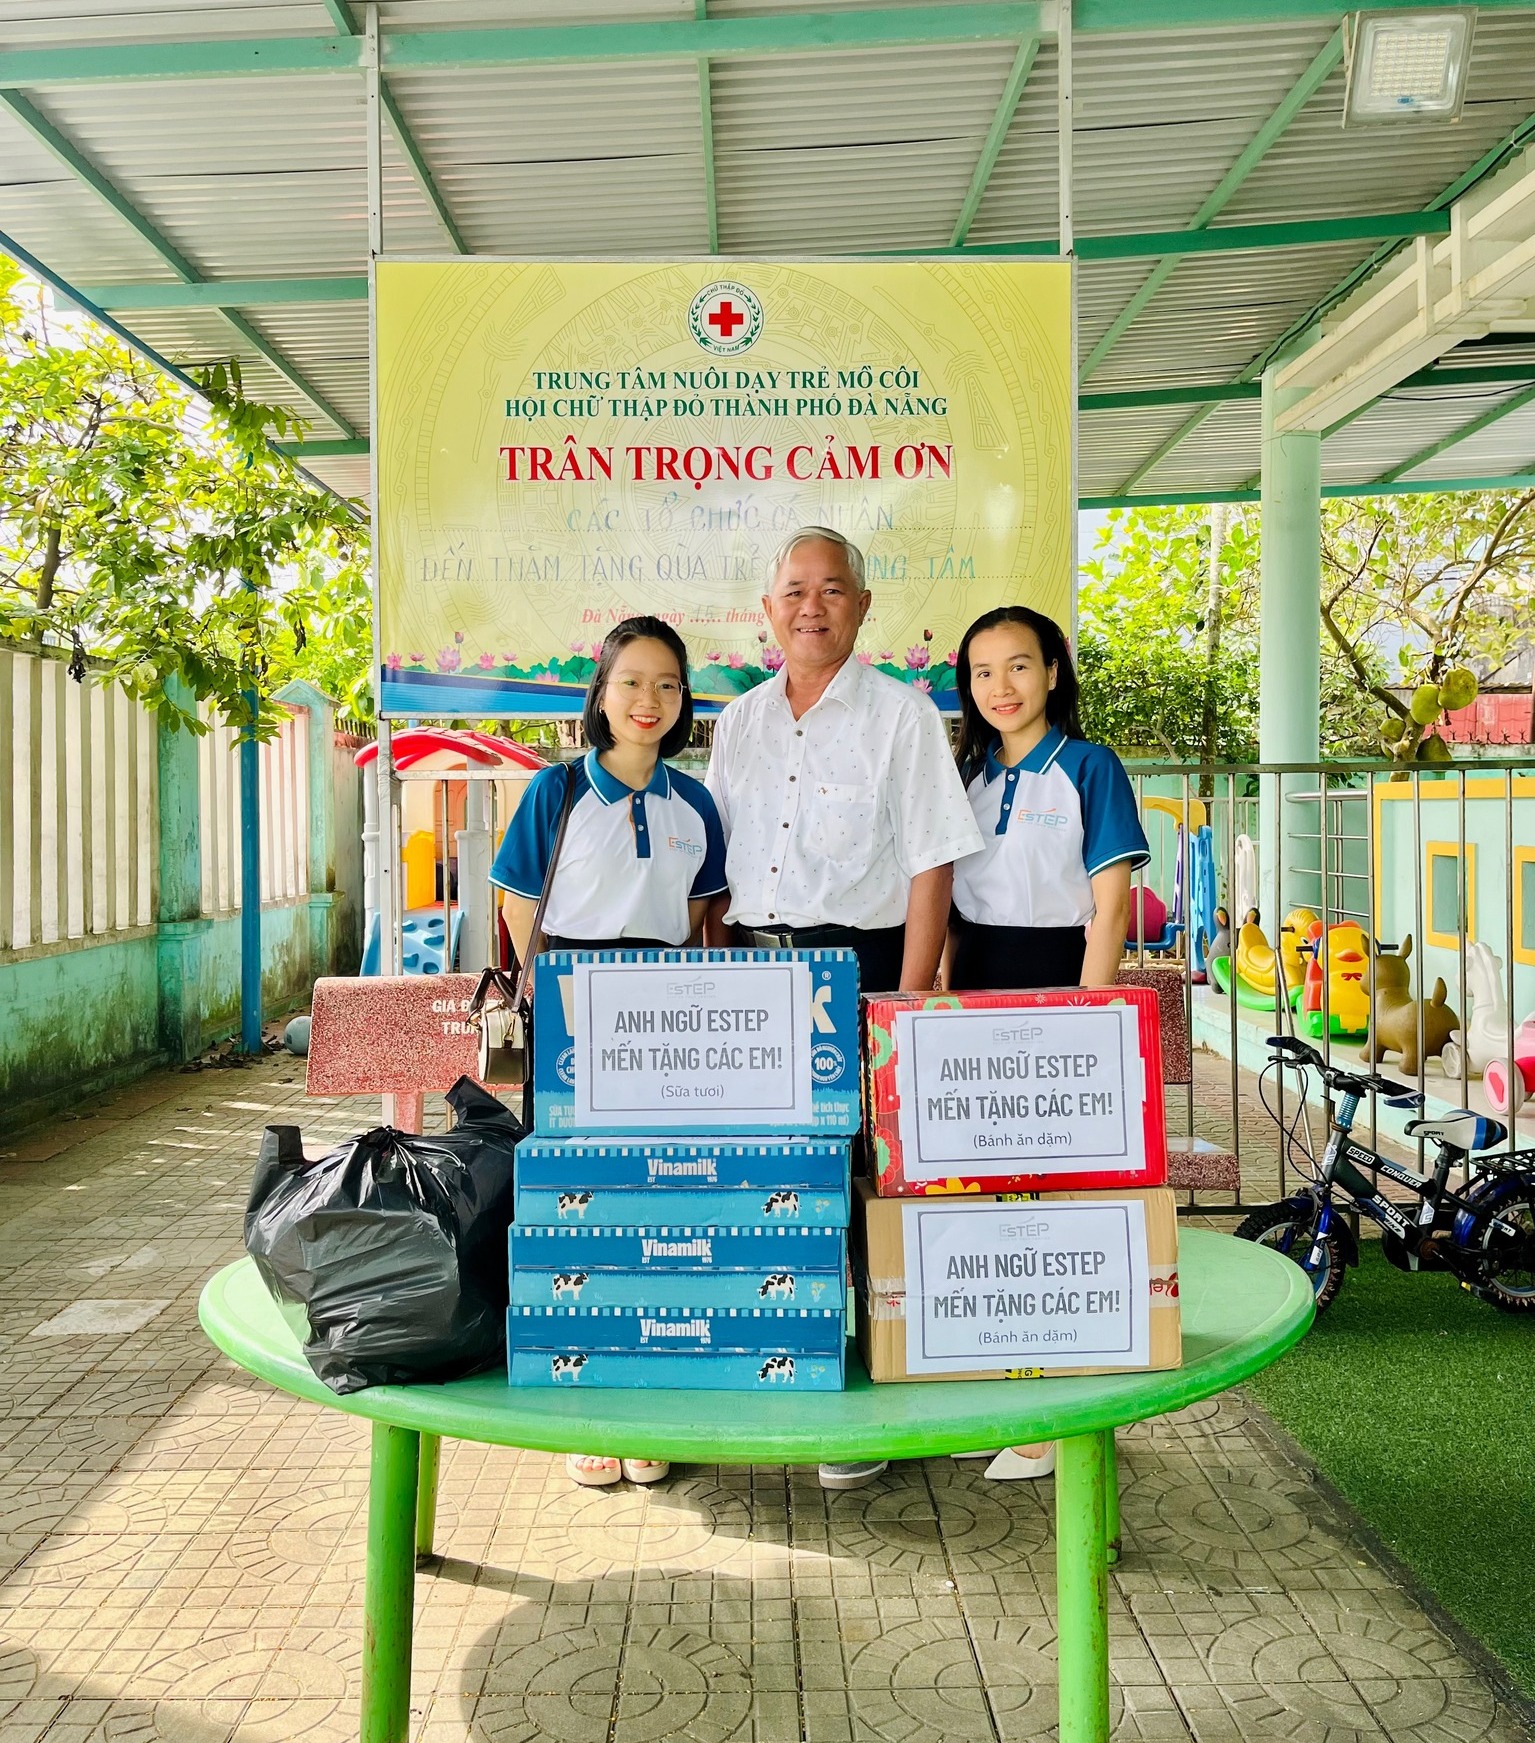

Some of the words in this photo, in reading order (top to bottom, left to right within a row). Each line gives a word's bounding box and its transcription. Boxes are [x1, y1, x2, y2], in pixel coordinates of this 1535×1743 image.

[533, 371, 611, 390] TRUNG
[616, 366, 667, 390] TÂM
[673, 366, 729, 390] NUÔI
[735, 371, 781, 394] DẠY
[786, 366, 830, 389] TRẺ
[836, 365, 873, 389] MỒ
[879, 365, 919, 389] CÔI
[505, 396, 546, 422] HỘI
[553, 394, 604, 417] CHỮ
[608, 396, 668, 422] THẬP
[673, 393, 705, 417] ĐỎ
[710, 393, 789, 417] THÀNH
[796, 392, 842, 416] PHỐ
[848, 392, 878, 416] ĐÀ
[884, 392, 948, 416] NẴNG
[499, 434, 614, 481] TRÂN
[625, 446, 774, 491] TRỌNG
[786, 434, 882, 481] CẢM
[893, 441, 954, 480] ƠN
[582, 608, 602, 624] Đà
[725, 609, 765, 628] tháng
[432, 1000, 456, 1013] GIA
[614, 1009, 655, 1033] ANH
[661, 1004, 703, 1033] NGỮ
[707, 1009, 769, 1032] ESTEP
[601, 1039, 643, 1071] MẾN
[648, 1042, 700, 1077] TẶNG
[705, 1041, 744, 1071] CÁC
[749, 1046, 783, 1070] EM!
[940, 1057, 981, 1082] ANH
[987, 1050, 1032, 1081] NGỮ
[1035, 1054, 1098, 1079] ESTEP
[660, 1085, 691, 1099] (Sữa
[694, 1085, 724, 1099] tươi)
[928, 1089, 971, 1121] MẾN
[976, 1091, 1029, 1126] TẶNG
[1035, 1089, 1074, 1118] CÁC
[1079, 1092, 1114, 1117] EM!
[973, 1134, 1013, 1149] (Bánh
[1016, 1132, 1034, 1146] ăn
[1037, 1131, 1072, 1148] dặm)
[647, 1158, 718, 1176] Vinamilk
[1348, 1147, 1374, 1163] SPEED
[1380, 1165, 1423, 1188] CONQUER
[1372, 1194, 1410, 1227] SPORT
[641, 1238, 712, 1257] Vinamilk
[946, 1255, 989, 1280] ANH
[995, 1247, 1038, 1278] NGỮ
[1042, 1251, 1106, 1276] ESTEP
[933, 1286, 977, 1318] MẾN
[982, 1289, 1036, 1323] TẶNG
[1042, 1286, 1080, 1315] CÁC
[1086, 1290, 1121, 1314] EM!
[640, 1318, 711, 1337] Vinamilk
[978, 1331, 1018, 1346] (Bánh
[1021, 1330, 1039, 1344] ăn
[1042, 1328, 1078, 1344] dặm)
